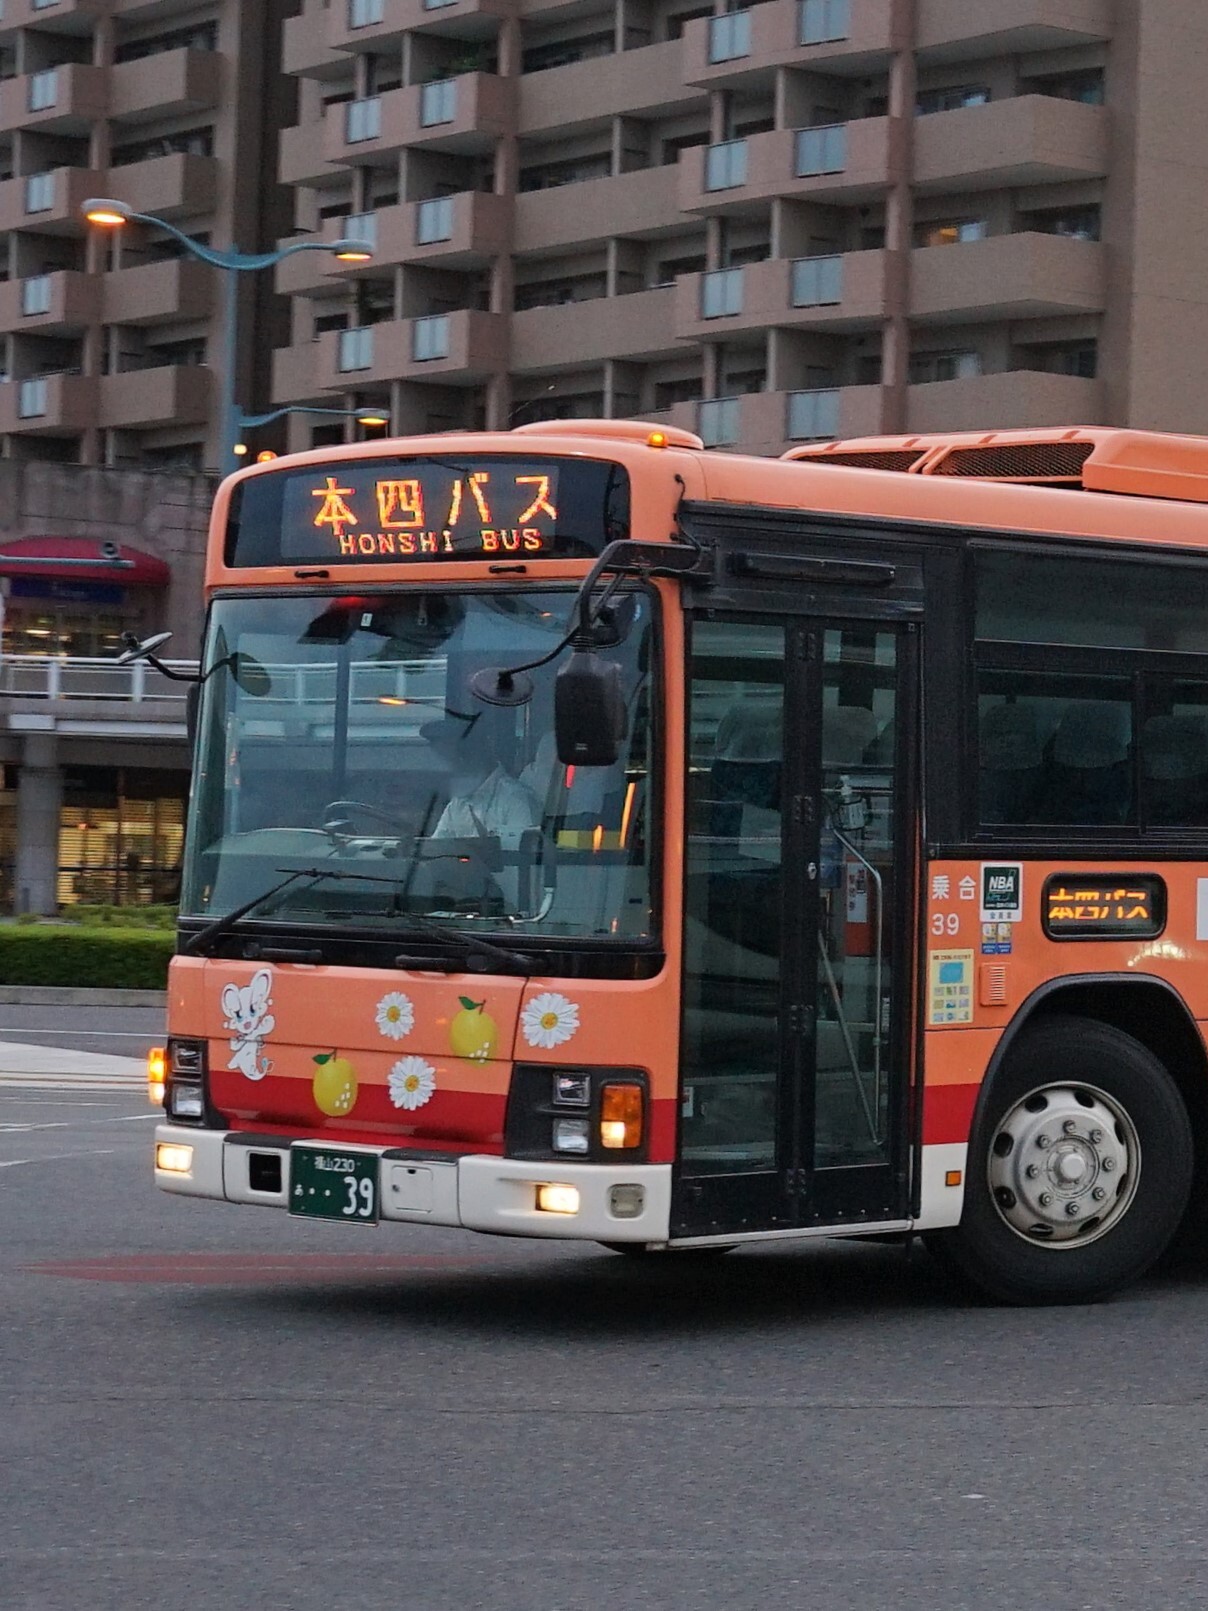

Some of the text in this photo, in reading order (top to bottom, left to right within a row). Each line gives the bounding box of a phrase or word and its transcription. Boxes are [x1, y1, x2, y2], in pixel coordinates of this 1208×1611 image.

[311, 471, 560, 536] 本四バス
[339, 527, 544, 556] HONSHI BUS
[932, 874, 977, 900] 乗合
[989, 875, 1015, 893] NBA
[931, 912, 959, 936] 39
[343, 1175, 374, 1217] 39
